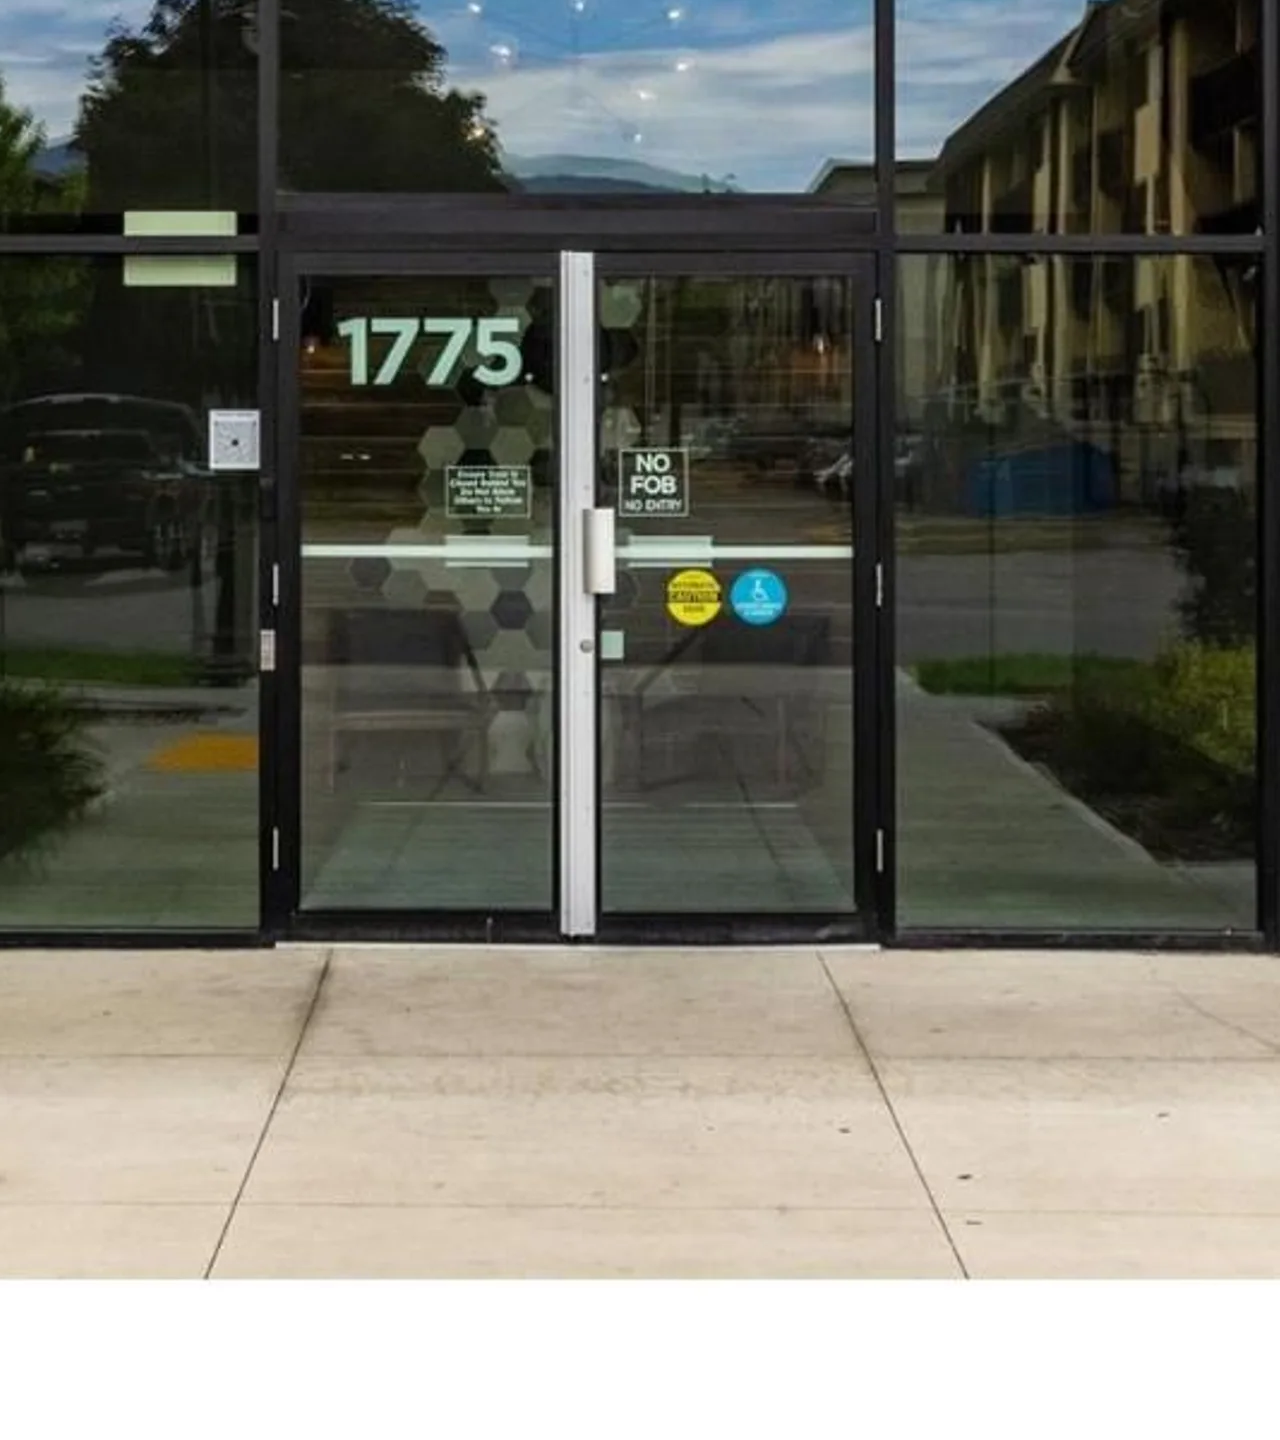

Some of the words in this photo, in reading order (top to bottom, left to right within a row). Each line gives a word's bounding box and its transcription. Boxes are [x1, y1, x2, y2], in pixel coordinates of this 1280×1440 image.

[337, 317, 524, 386] 1775
[635, 453, 671, 473] NO
[630, 475, 677, 495] FOB
